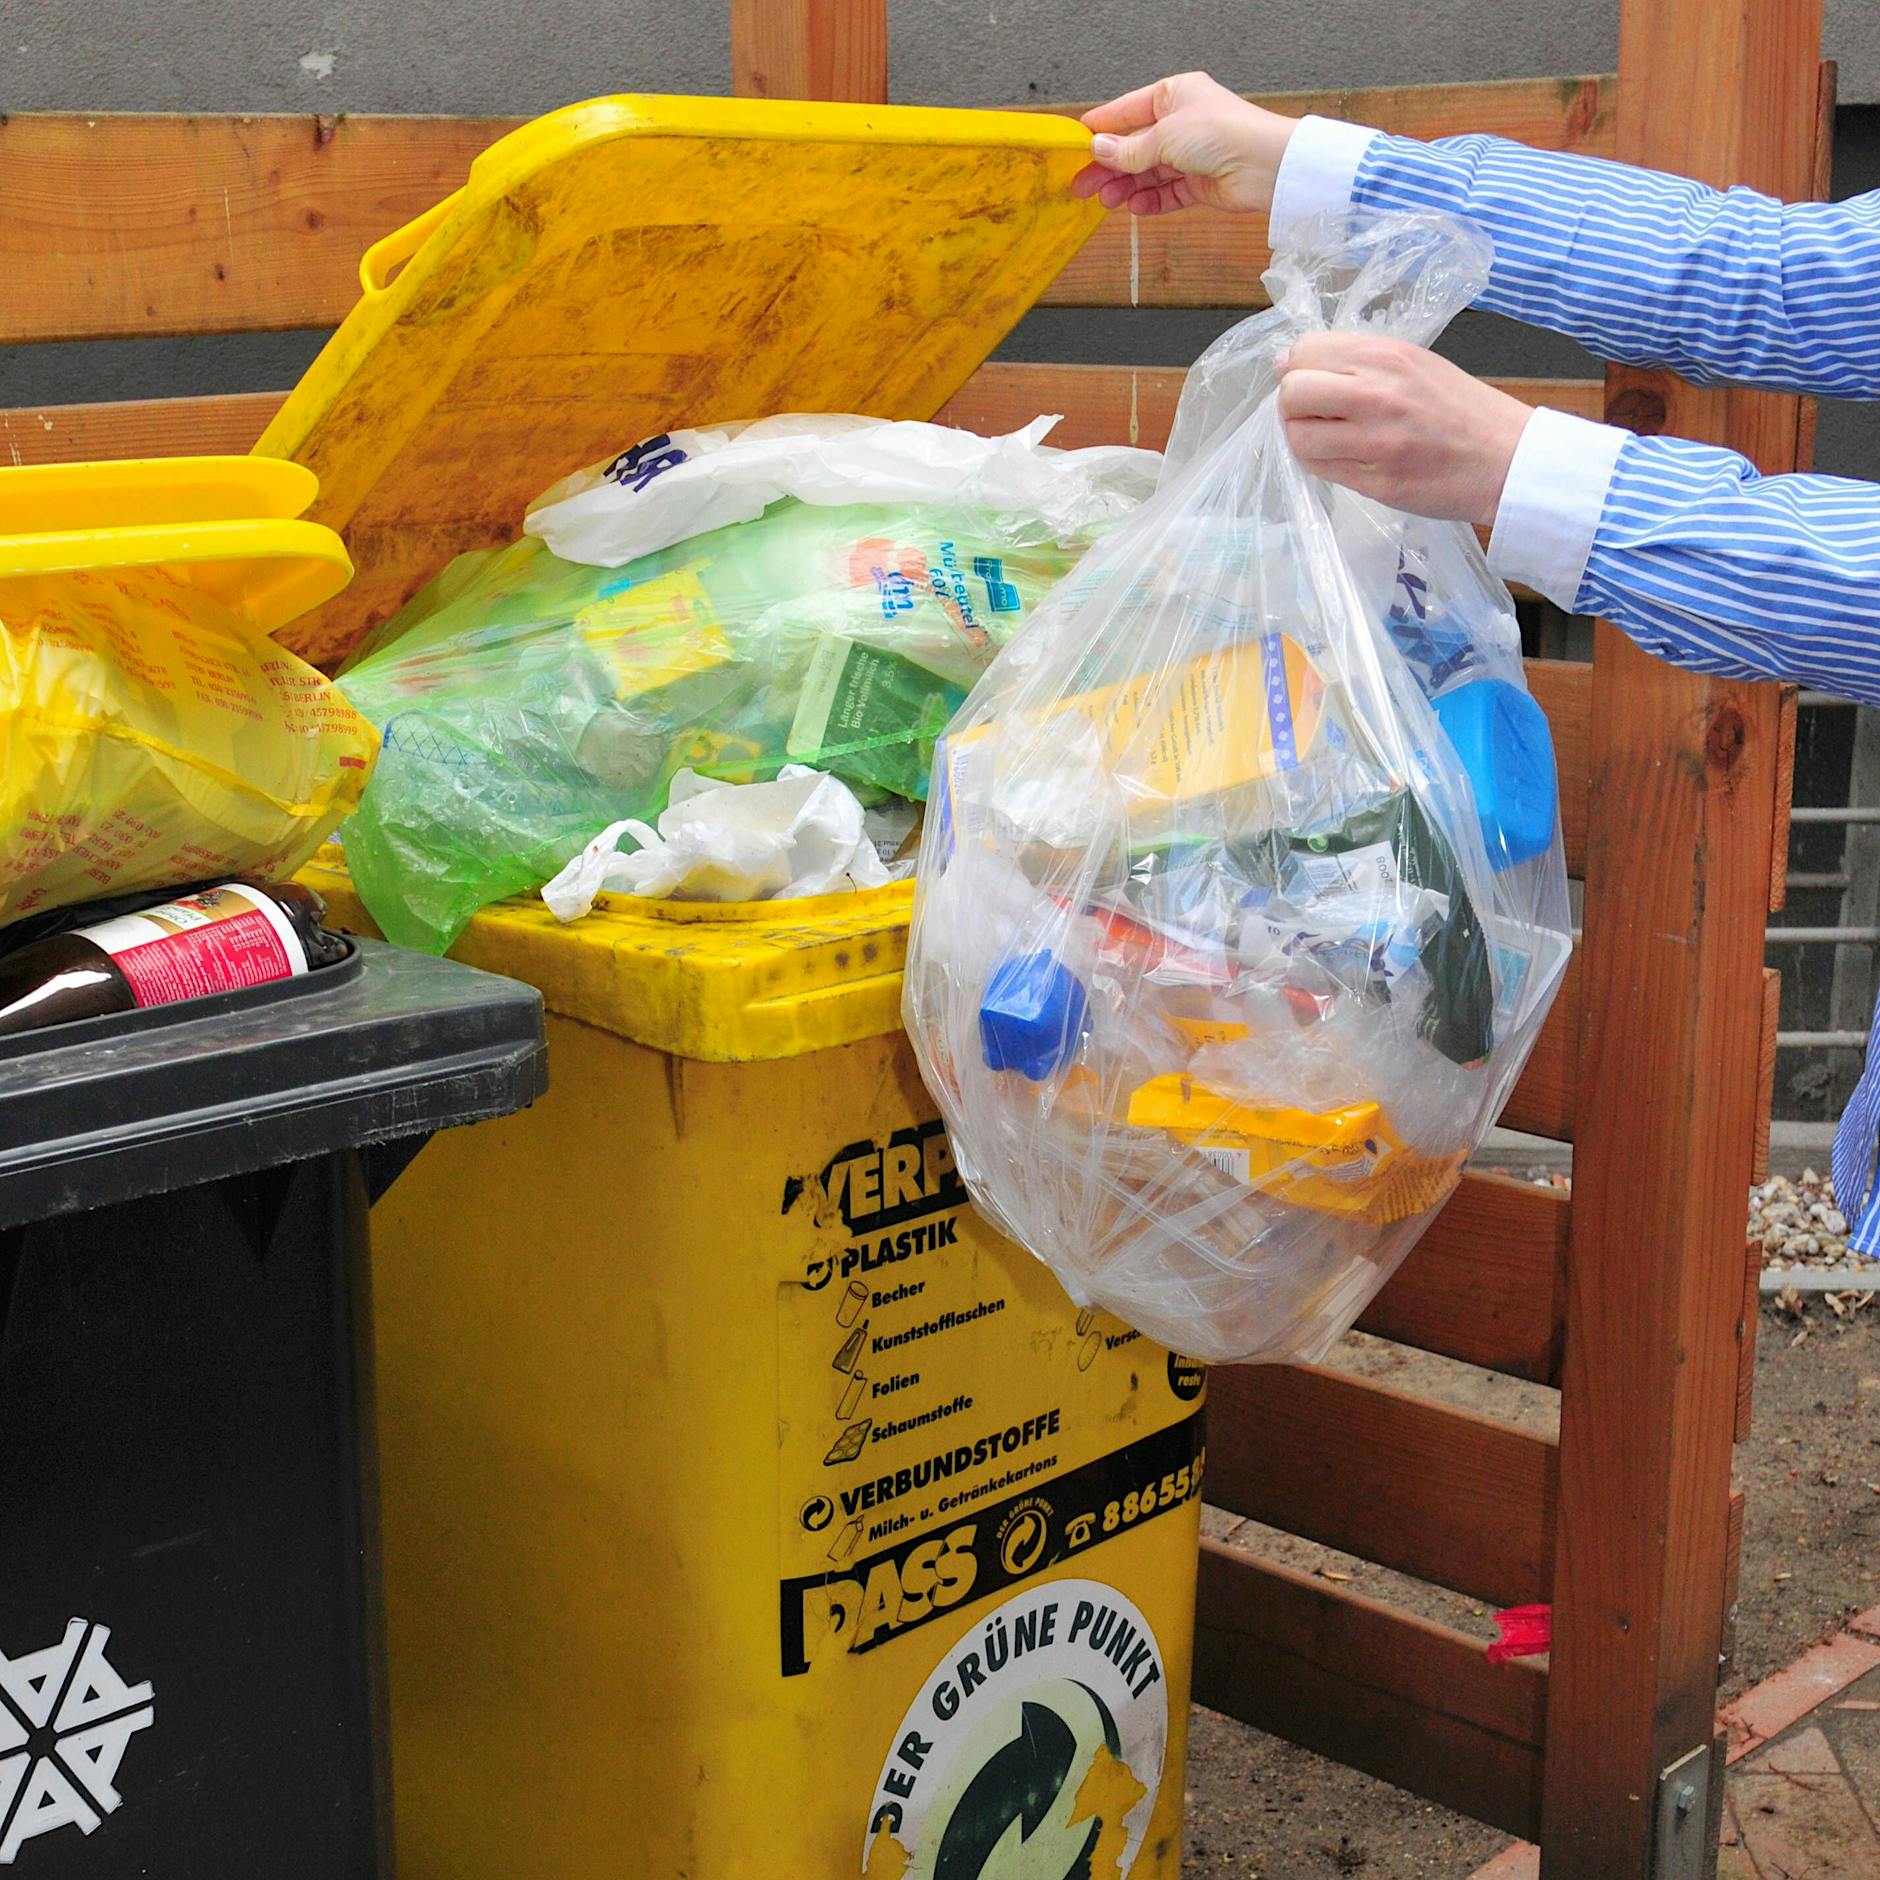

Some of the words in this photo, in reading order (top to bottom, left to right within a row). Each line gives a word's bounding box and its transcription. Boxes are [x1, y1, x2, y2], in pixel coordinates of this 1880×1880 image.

[849, 651, 870, 689] frische
[850, 710, 863, 729] Bio
[818, 1133, 965, 1223] VERP
[841, 1216, 959, 1278] PLASTIK
[872, 1280, 926, 1308] Becher
[872, 1299, 1005, 1354] Kunststofflaschen
[872, 1373, 920, 1399] Folien
[871, 1395, 974, 1444] Schaumstoffe
[840, 1408, 1060, 1517] VERBUNDSTOFFE
[868, 1512, 916, 1542] Milch-
[919, 1508, 934, 1521] u.
[937, 1455, 1058, 1513] Getränkekartons
[870, 1730, 934, 1835] DER
[932, 1602, 1059, 1722] GRÜNE
[1067, 1600, 1161, 1700] PUNKT
